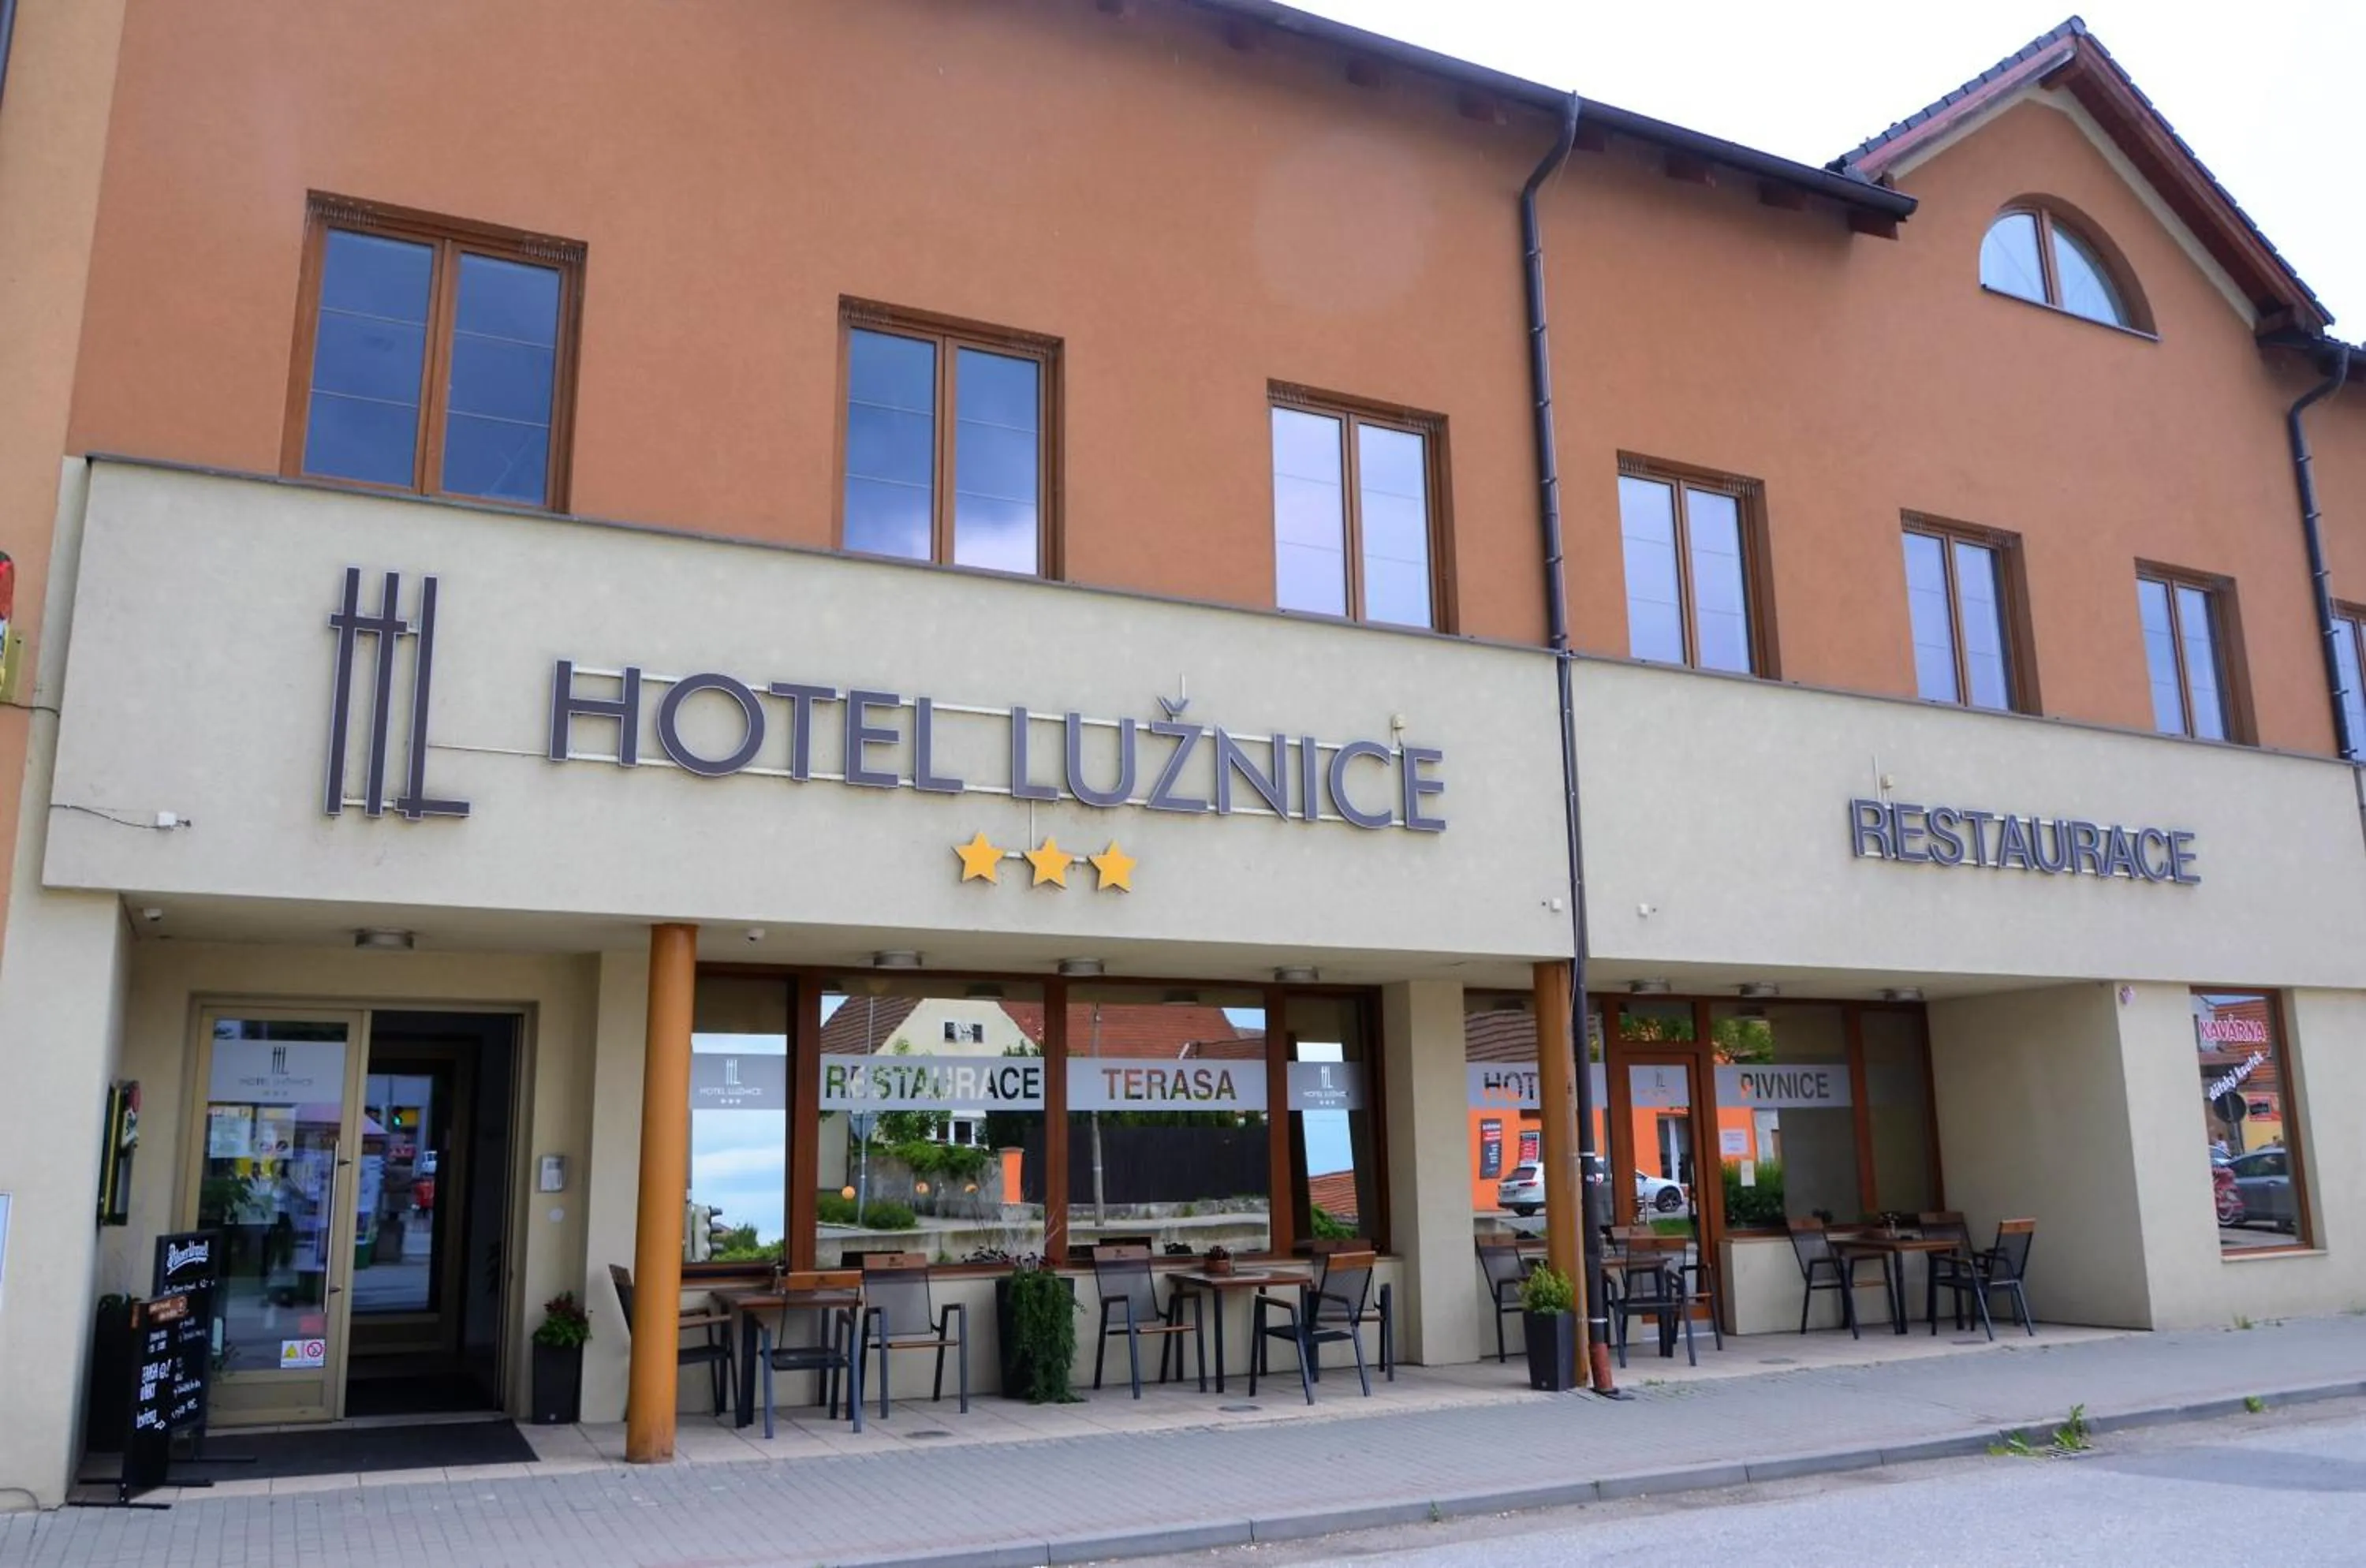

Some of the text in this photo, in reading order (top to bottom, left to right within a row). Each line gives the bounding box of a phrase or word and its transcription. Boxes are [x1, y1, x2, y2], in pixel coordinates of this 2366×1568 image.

[549, 659, 1447, 832] HOTEL LUŽNICE
[1850, 797, 2201, 885] RESTAURACE
[2200, 1013, 2266, 1042] KAVÁRNA
[825, 1065, 1040, 1099] RESTAURACE
[1101, 1069, 1237, 1101] TERASA
[1483, 1071, 1539, 1100] HOT
[1741, 1071, 1830, 1099] PIVNICE
